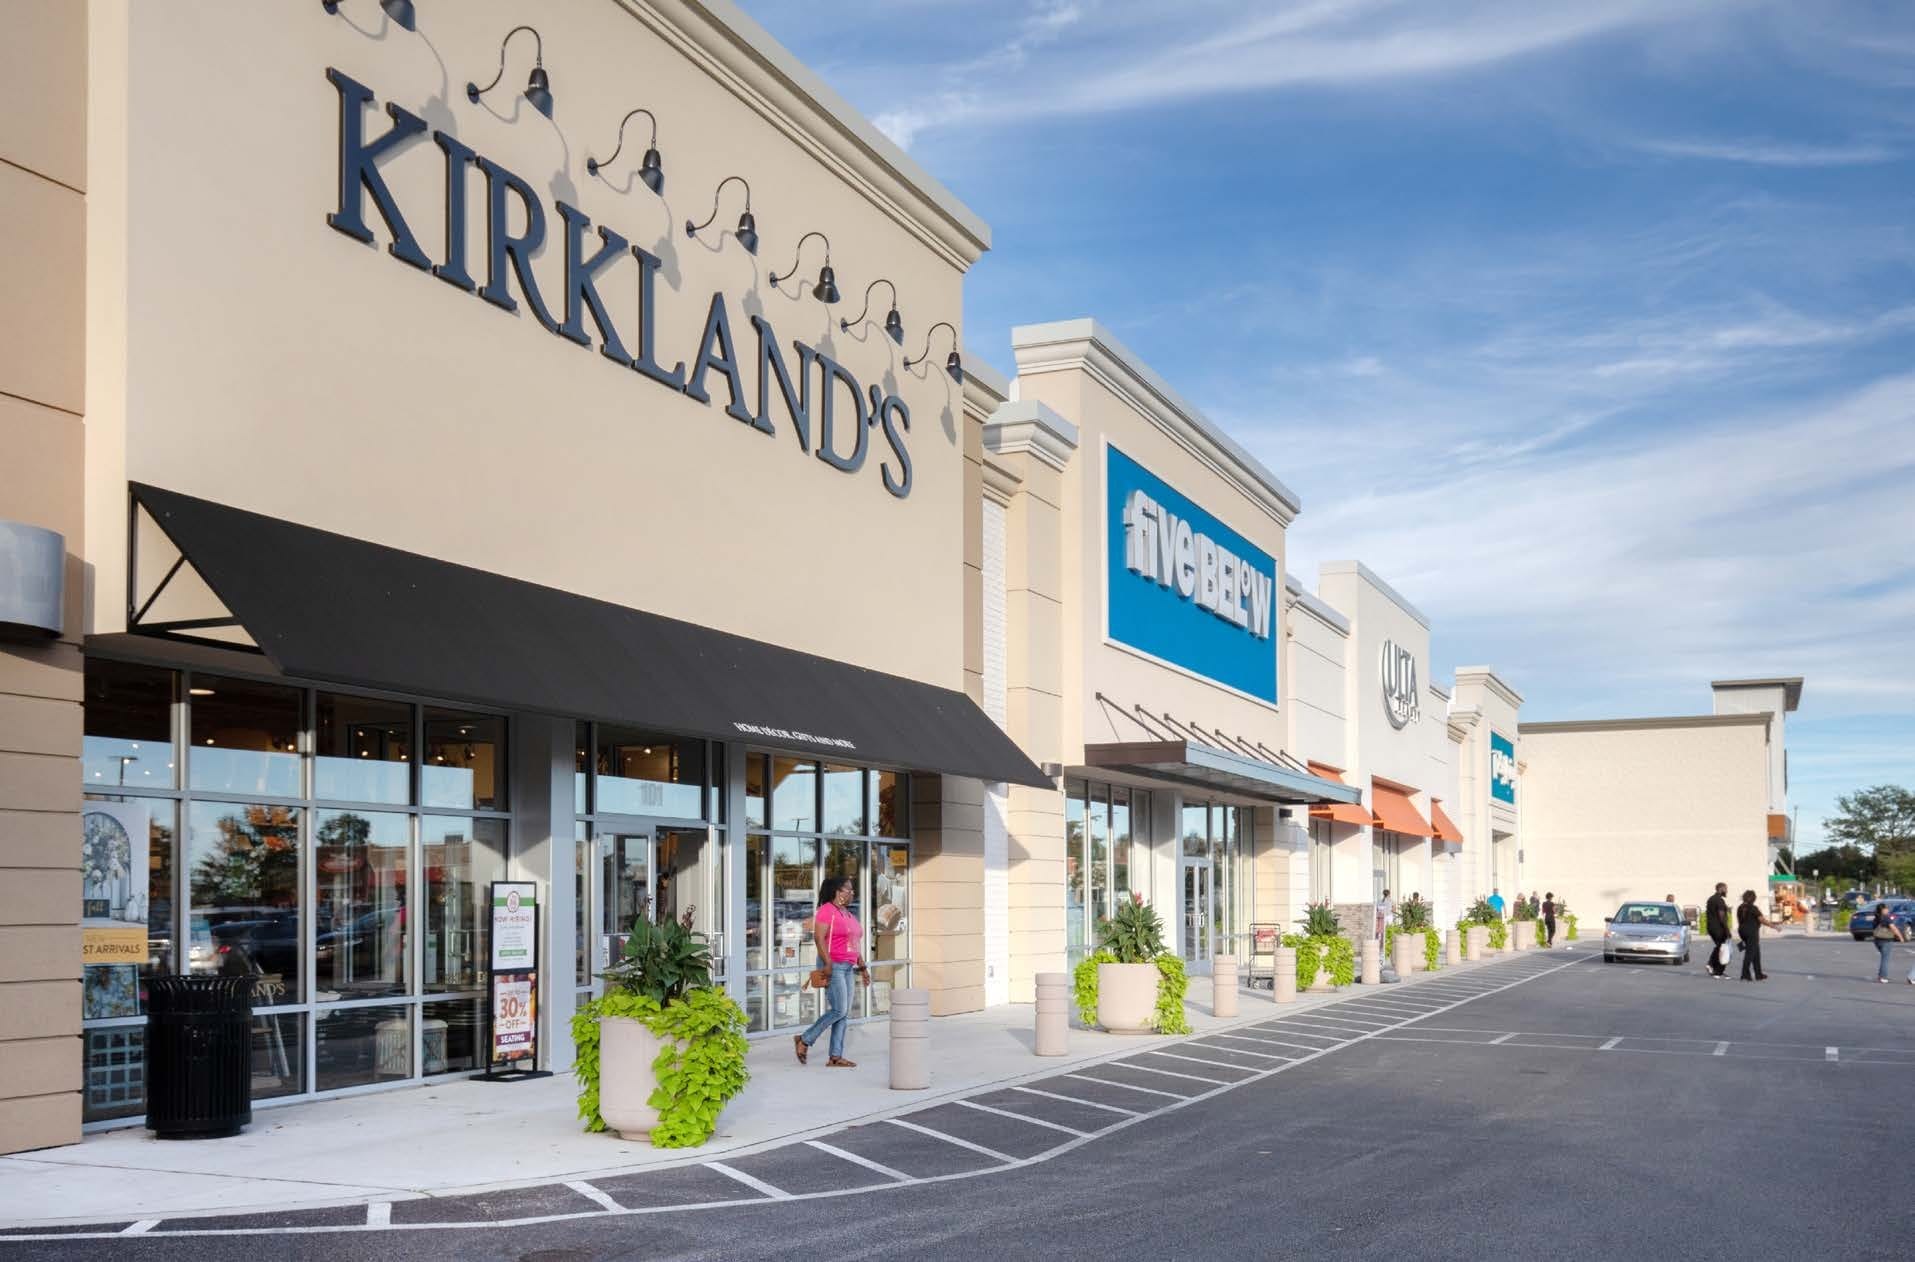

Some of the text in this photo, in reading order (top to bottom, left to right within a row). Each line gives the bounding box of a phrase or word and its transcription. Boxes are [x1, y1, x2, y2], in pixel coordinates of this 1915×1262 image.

[326, 66, 913, 499] KIRKLAND'S
[1123, 489, 1272, 640] five BELOW
[1382, 639, 1419, 712] ULTA
[96, 943, 141, 954] ARRIVALS
[500, 997, 528, 1019] 30%
[505, 1020, 520, 1029] OFF
